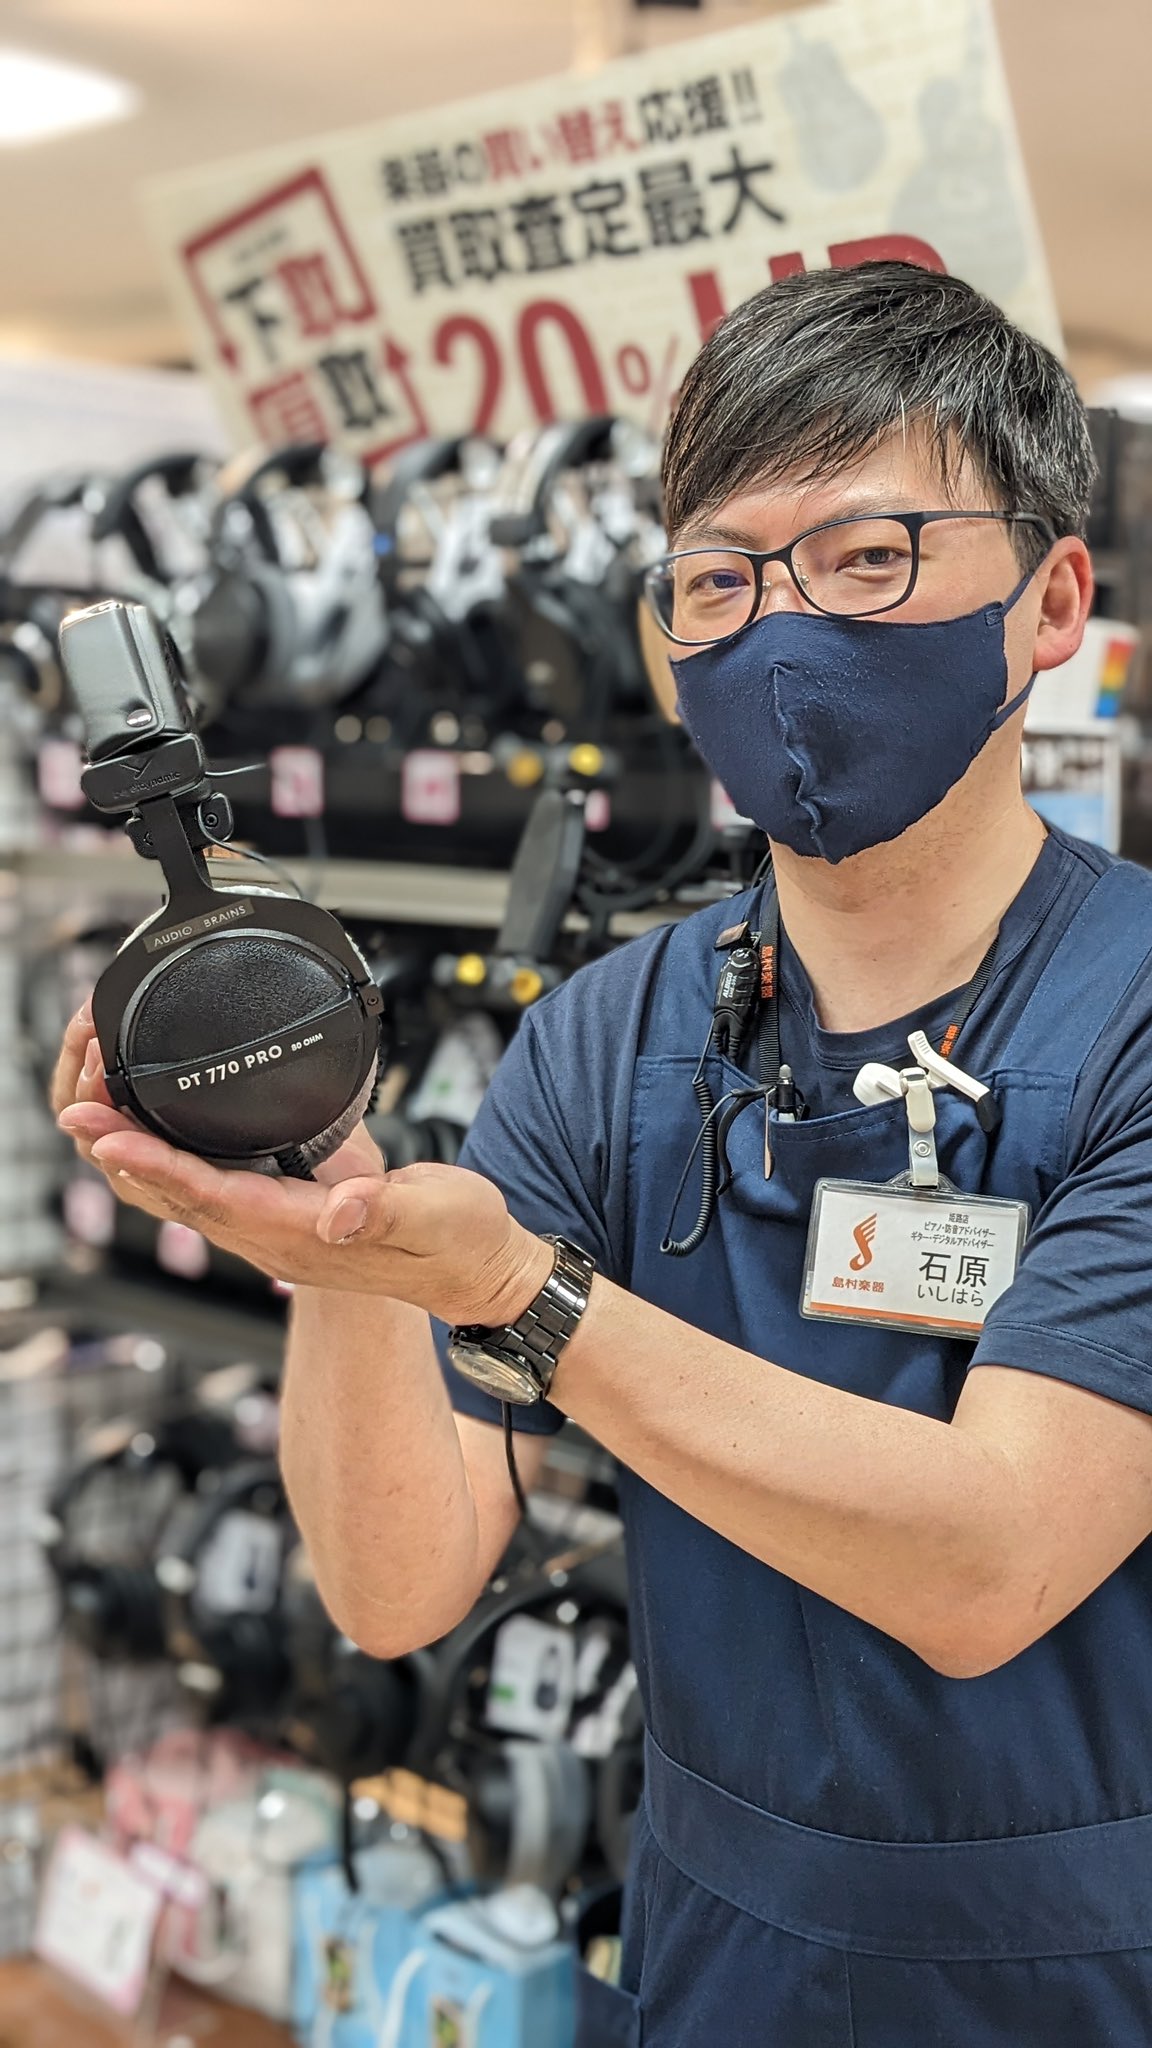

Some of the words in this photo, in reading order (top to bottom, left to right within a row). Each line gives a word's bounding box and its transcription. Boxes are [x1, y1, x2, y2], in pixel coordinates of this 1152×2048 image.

[397, 145, 787, 292] 買取査定最大
[153, 926, 193, 947] AUDIO
[203, 905, 246, 928] BRAINS
[177, 1072, 201, 1091] DT
[205, 1061, 240, 1084] 770
[244, 1045, 283, 1068] PRO
[291, 1041, 303, 1051] 80
[303, 1032, 324, 1047] OHM
[831, 1276, 885, 1293] 島村楽器
[919, 1252, 990, 1288] 石原
[917, 1284, 984, 1307] いしはら
